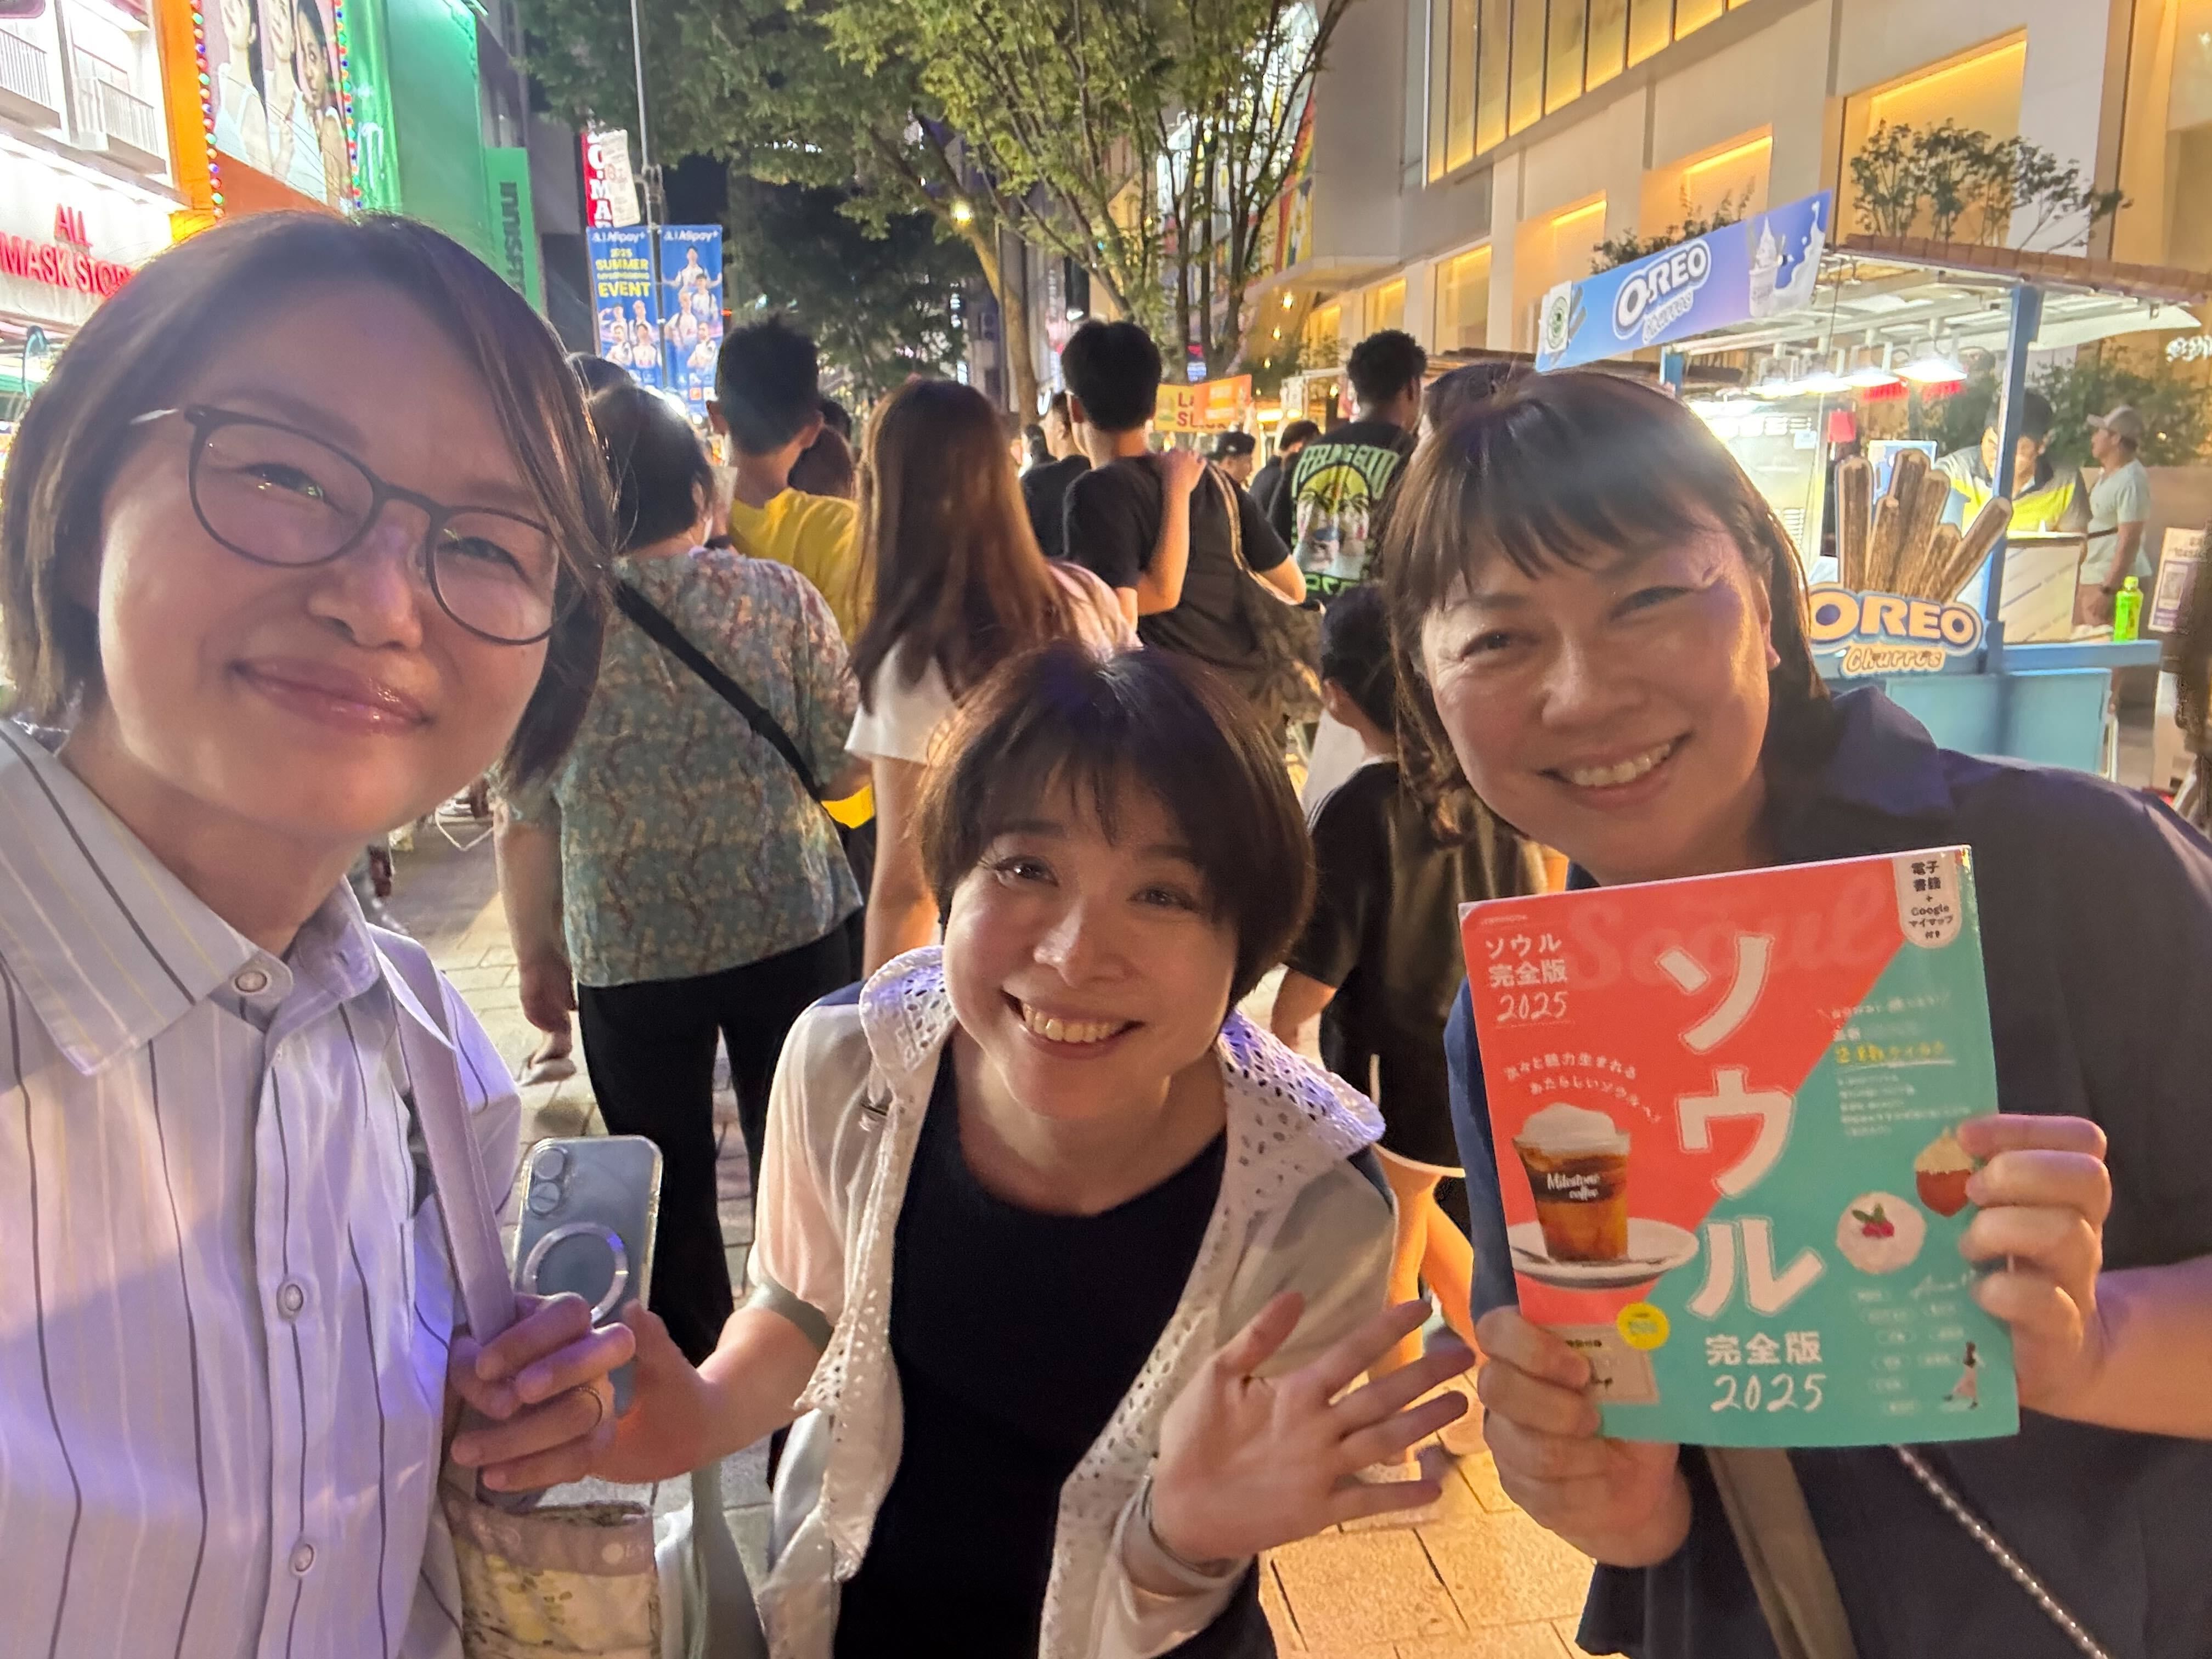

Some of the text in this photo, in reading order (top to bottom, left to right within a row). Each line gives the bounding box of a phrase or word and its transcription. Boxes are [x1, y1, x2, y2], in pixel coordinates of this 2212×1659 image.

[54, 204, 93, 247] ALL
[0, 230, 71, 289] MASK
[595, 258, 649, 270] SUMMER
[598, 281, 651, 297] EVENT
[1618, 246, 1707, 328] OREO
[1810, 591, 1974, 645] OREO
[1845, 646, 1943, 673] Churros
[1911, 904, 1950, 916] Google
[1485, 933, 1563, 960] ソウル
[1488, 959, 1568, 988] 完全版
[1497, 991, 1568, 1022] 2025
[1656, 933, 1825, 1318] ソウル
[1705, 1331, 1822, 1367] 完全版
[1709, 1372, 1827, 1412] 2025
